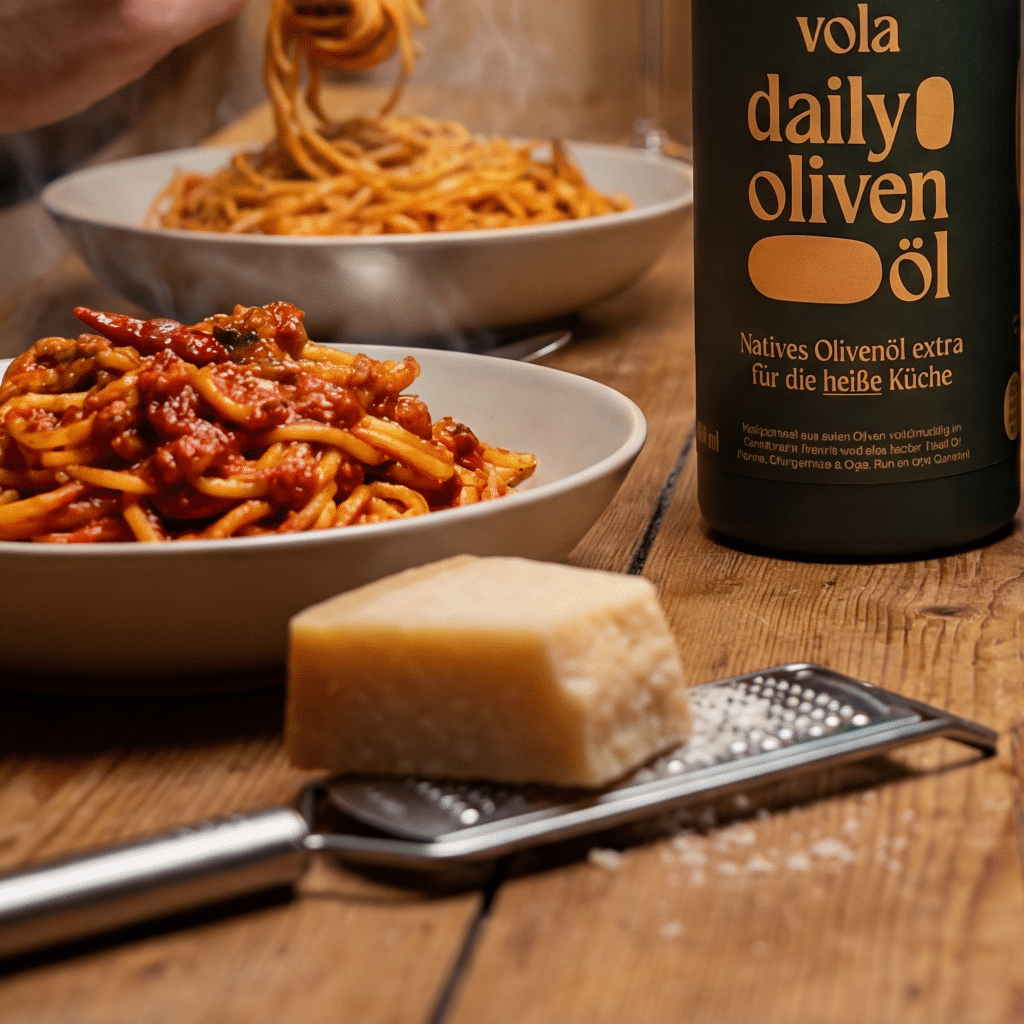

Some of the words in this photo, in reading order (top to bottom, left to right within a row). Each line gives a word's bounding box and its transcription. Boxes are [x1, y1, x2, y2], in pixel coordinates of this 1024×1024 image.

[796, 3, 900, 54] vola
[748, 73, 911, 163] daily
[748, 154, 949, 224] oliven
[889, 230, 950, 302] öl
[740, 331, 809, 361] Natives
[814, 337, 906, 362] Olivenöl
[912, 336, 964, 359] extra
[751, 362, 780, 388] für
[785, 367, 817, 392] die
[823, 368, 883, 393] heiße
[889, 364, 953, 391] Küche
